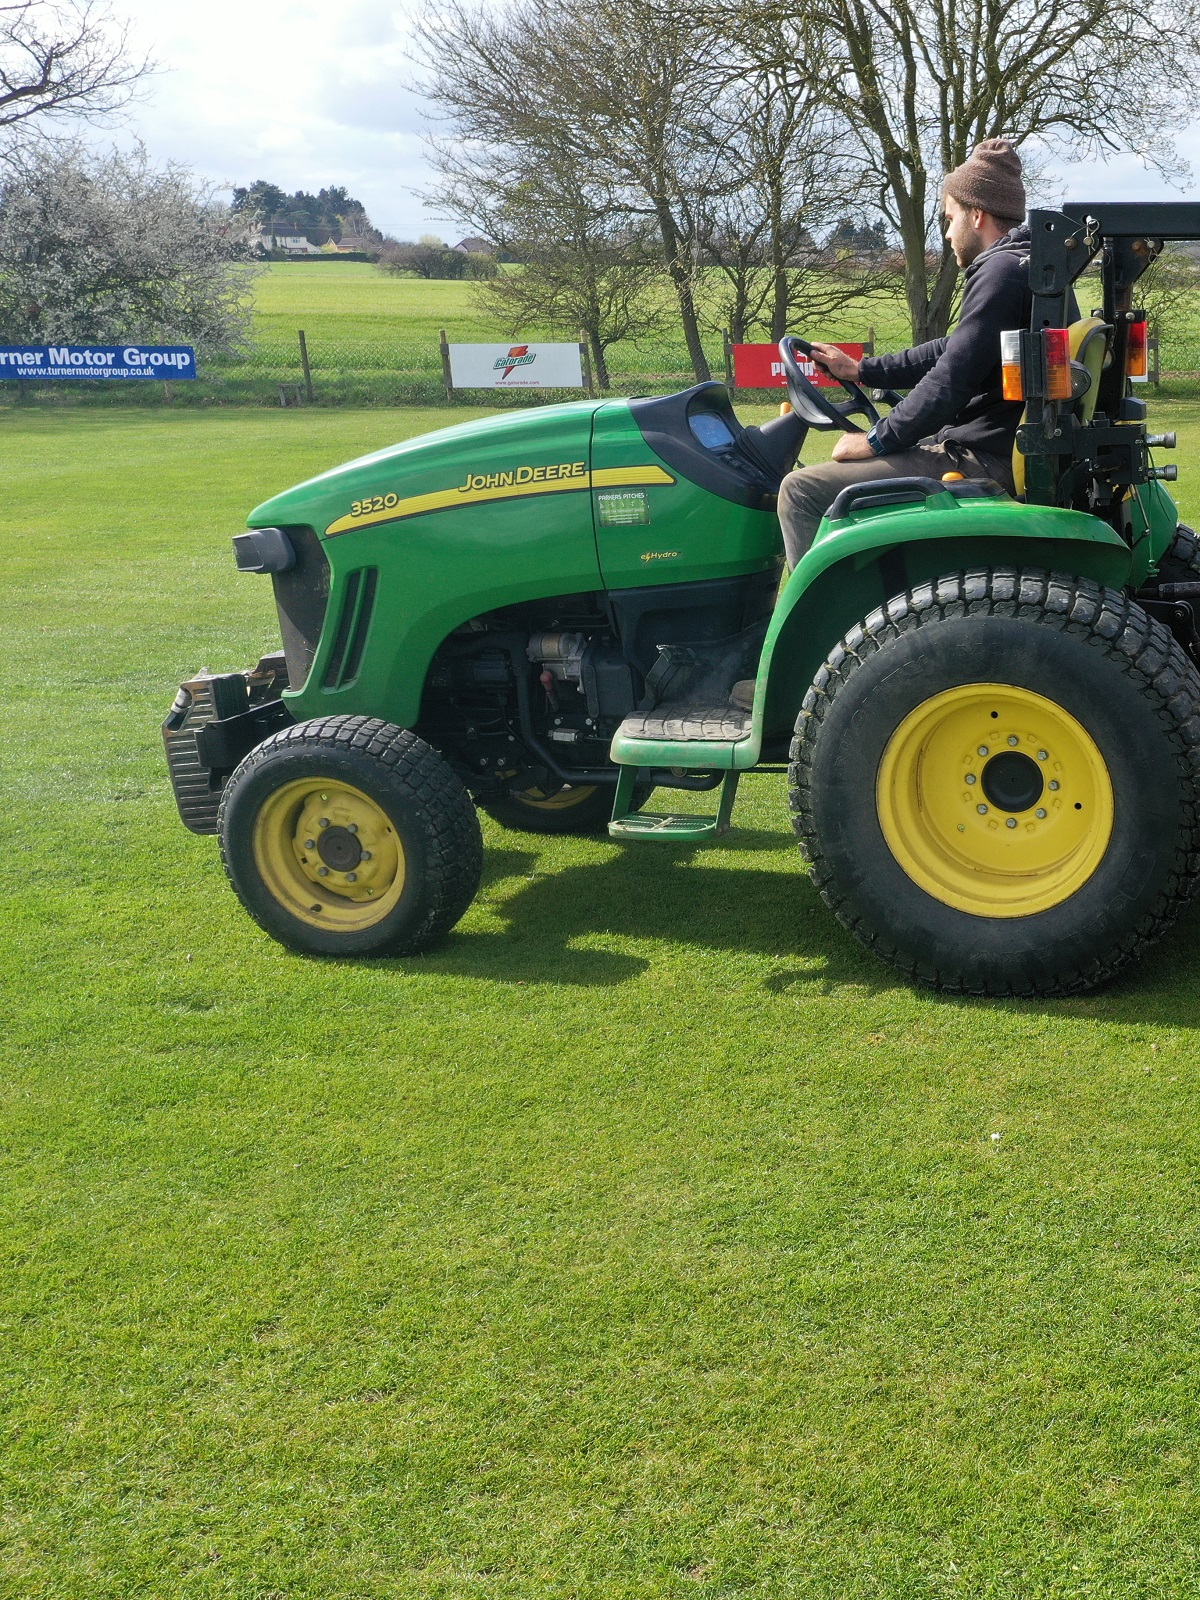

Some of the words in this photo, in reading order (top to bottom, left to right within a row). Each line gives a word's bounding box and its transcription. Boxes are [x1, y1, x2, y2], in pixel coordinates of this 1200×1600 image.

[49, 348, 115, 366] Motor
[123, 347, 191, 369] Group
[494, 353, 534, 367] Gatorade
[17, 366, 155, 377] www.turnermotorgroup.co.uk
[458, 472, 514, 492] JOHN
[515, 461, 585, 484] DEERE
[351, 492, 398, 517] 3520
[623, 492, 645, 500] PITCHES
